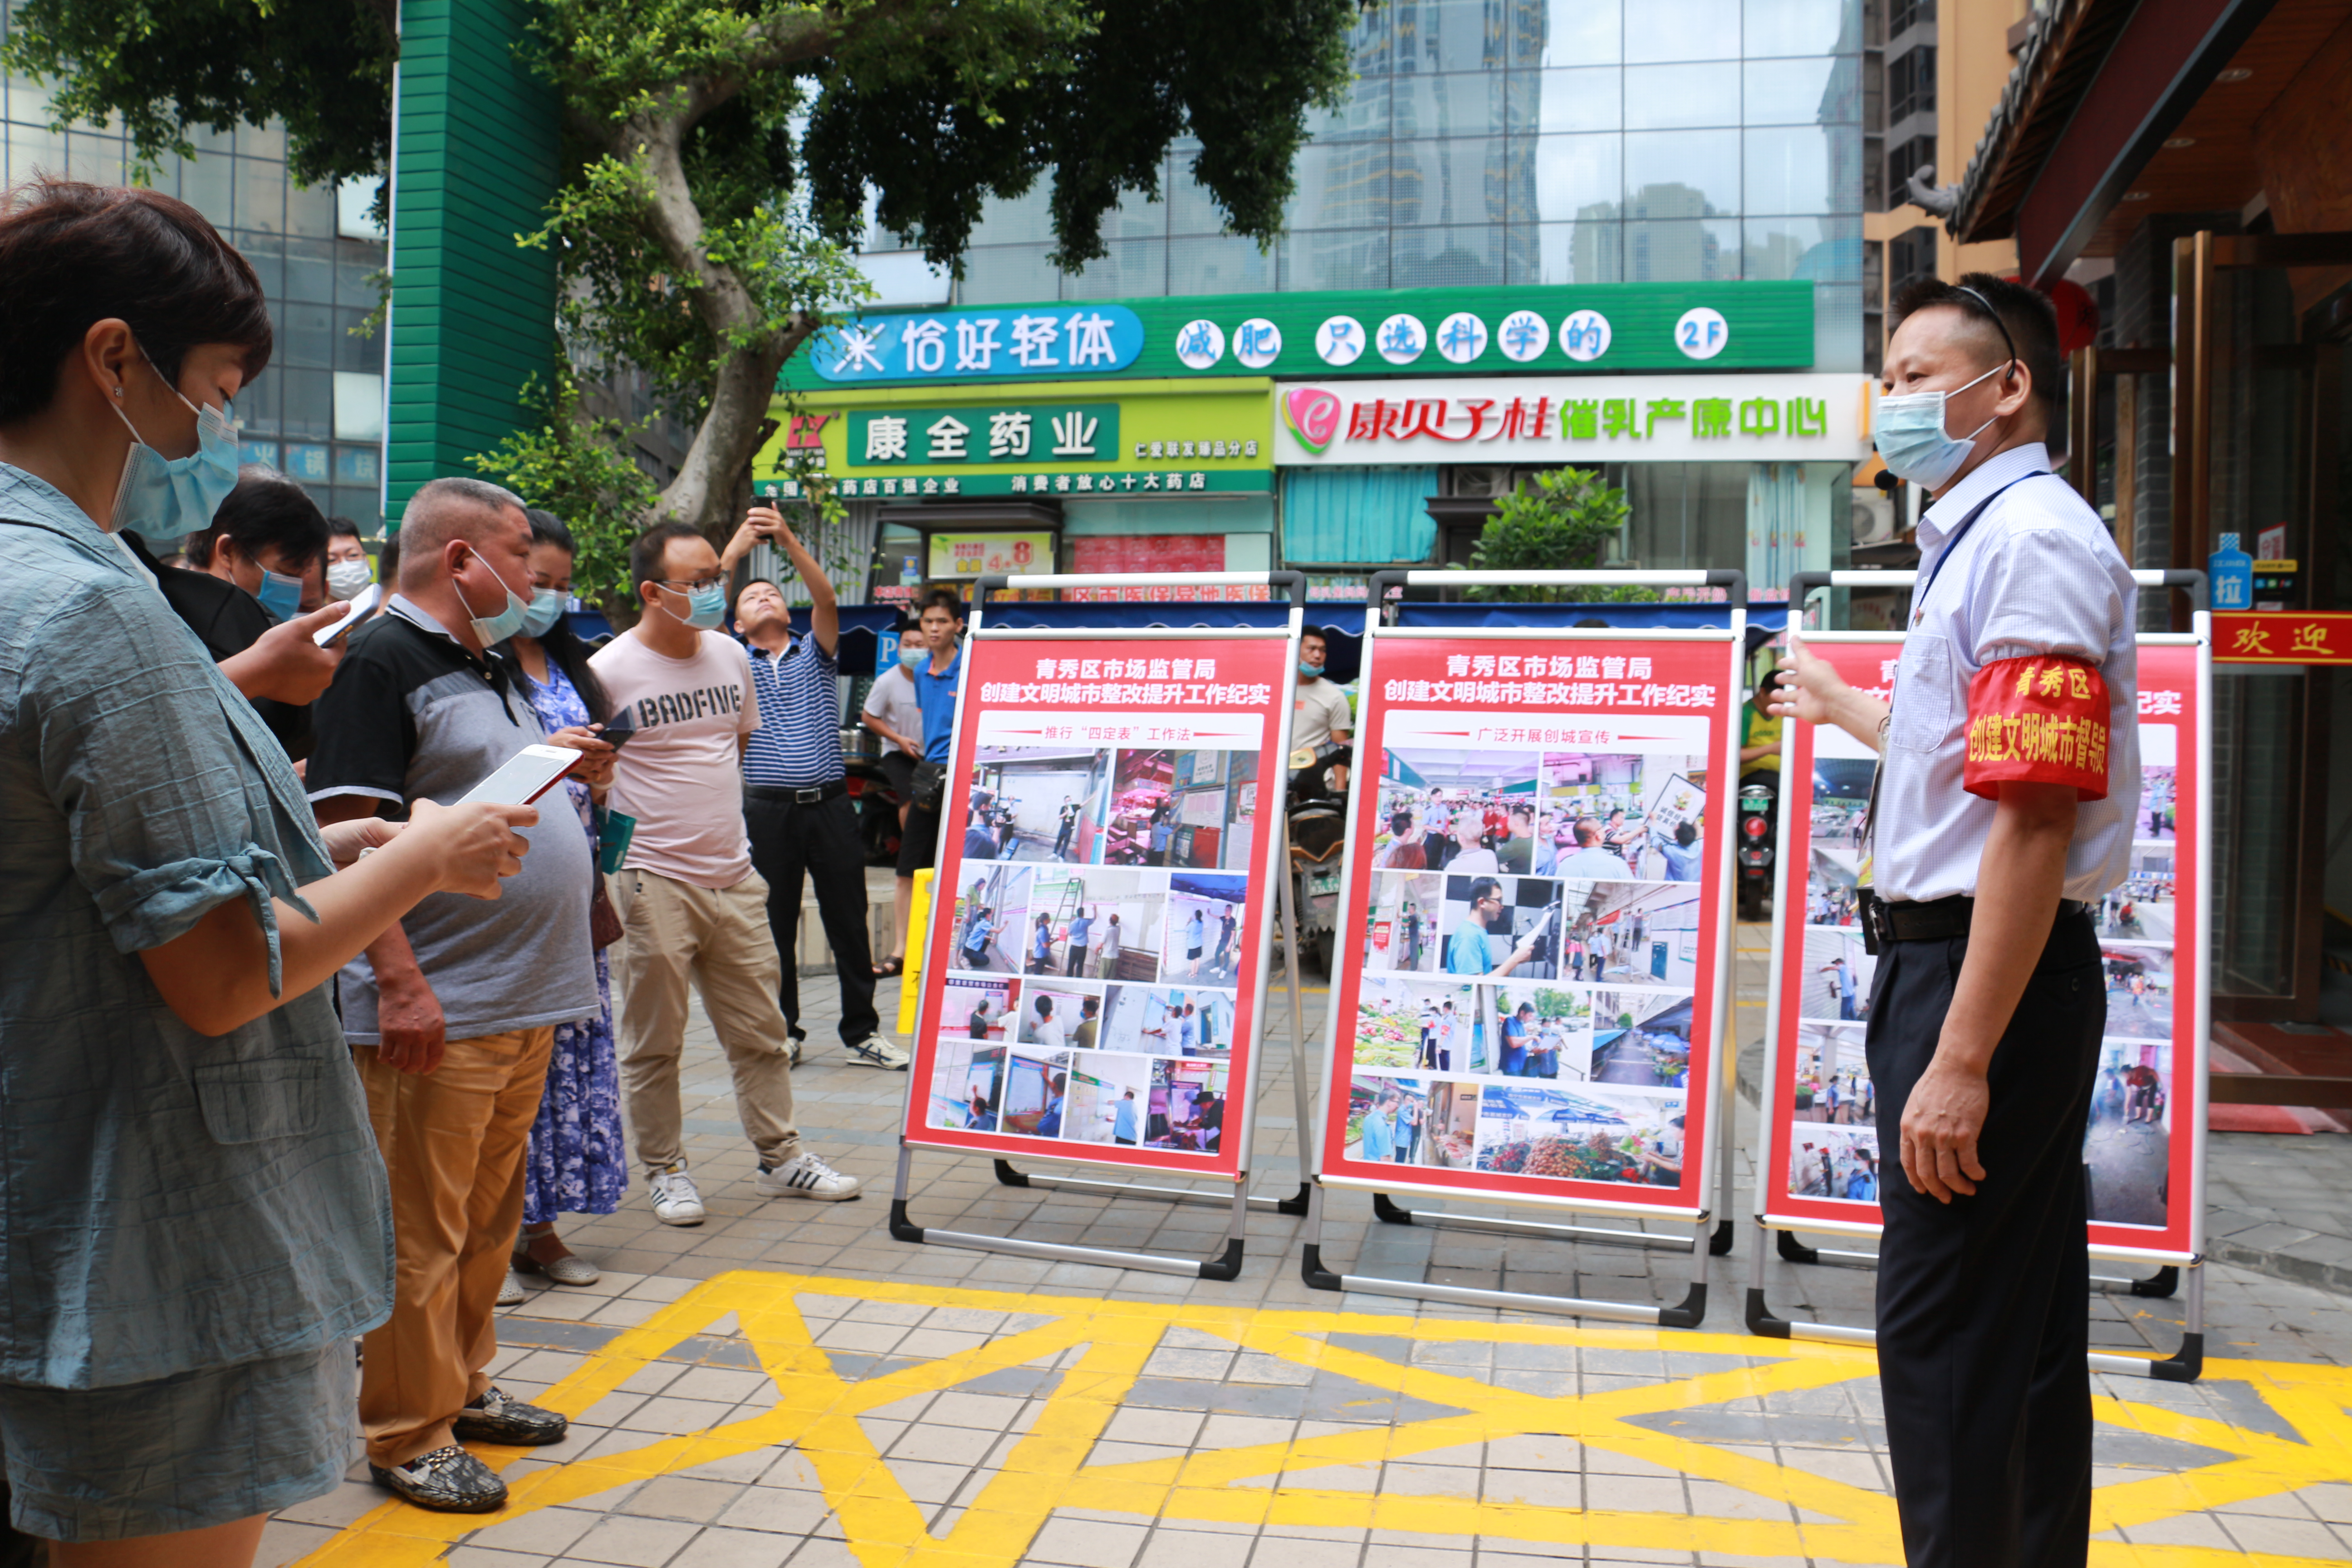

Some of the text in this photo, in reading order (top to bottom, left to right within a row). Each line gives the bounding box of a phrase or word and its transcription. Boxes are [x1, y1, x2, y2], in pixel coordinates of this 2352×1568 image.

[901, 312, 1117, 372] 恰好轻体
[1179, 316, 1721, 359] 减肥 只选科学的 2F
[865, 411, 1098, 461] 康全药业
[1011, 472, 1206, 492] 消费者放心十大药店
[2215, 575, 2243, 604] 拉
[880, 637, 897, 662] P
[2231, 620, 2336, 655] 欢迎
[1036, 658, 1217, 680] 青秀区市场监管局
[1446, 654, 1653, 680] 青秀区市场监管局
[980, 681, 1272, 706] 创建文明城市整改提升工作纪实
[1384, 678, 1716, 707] 创建文明城市整改提升工作纪实
[2014, 665, 2092, 700] 青秀区
[637, 683, 741, 728] BADFIVE
[1476, 727, 1611, 745] 广泛开展创城宣传
